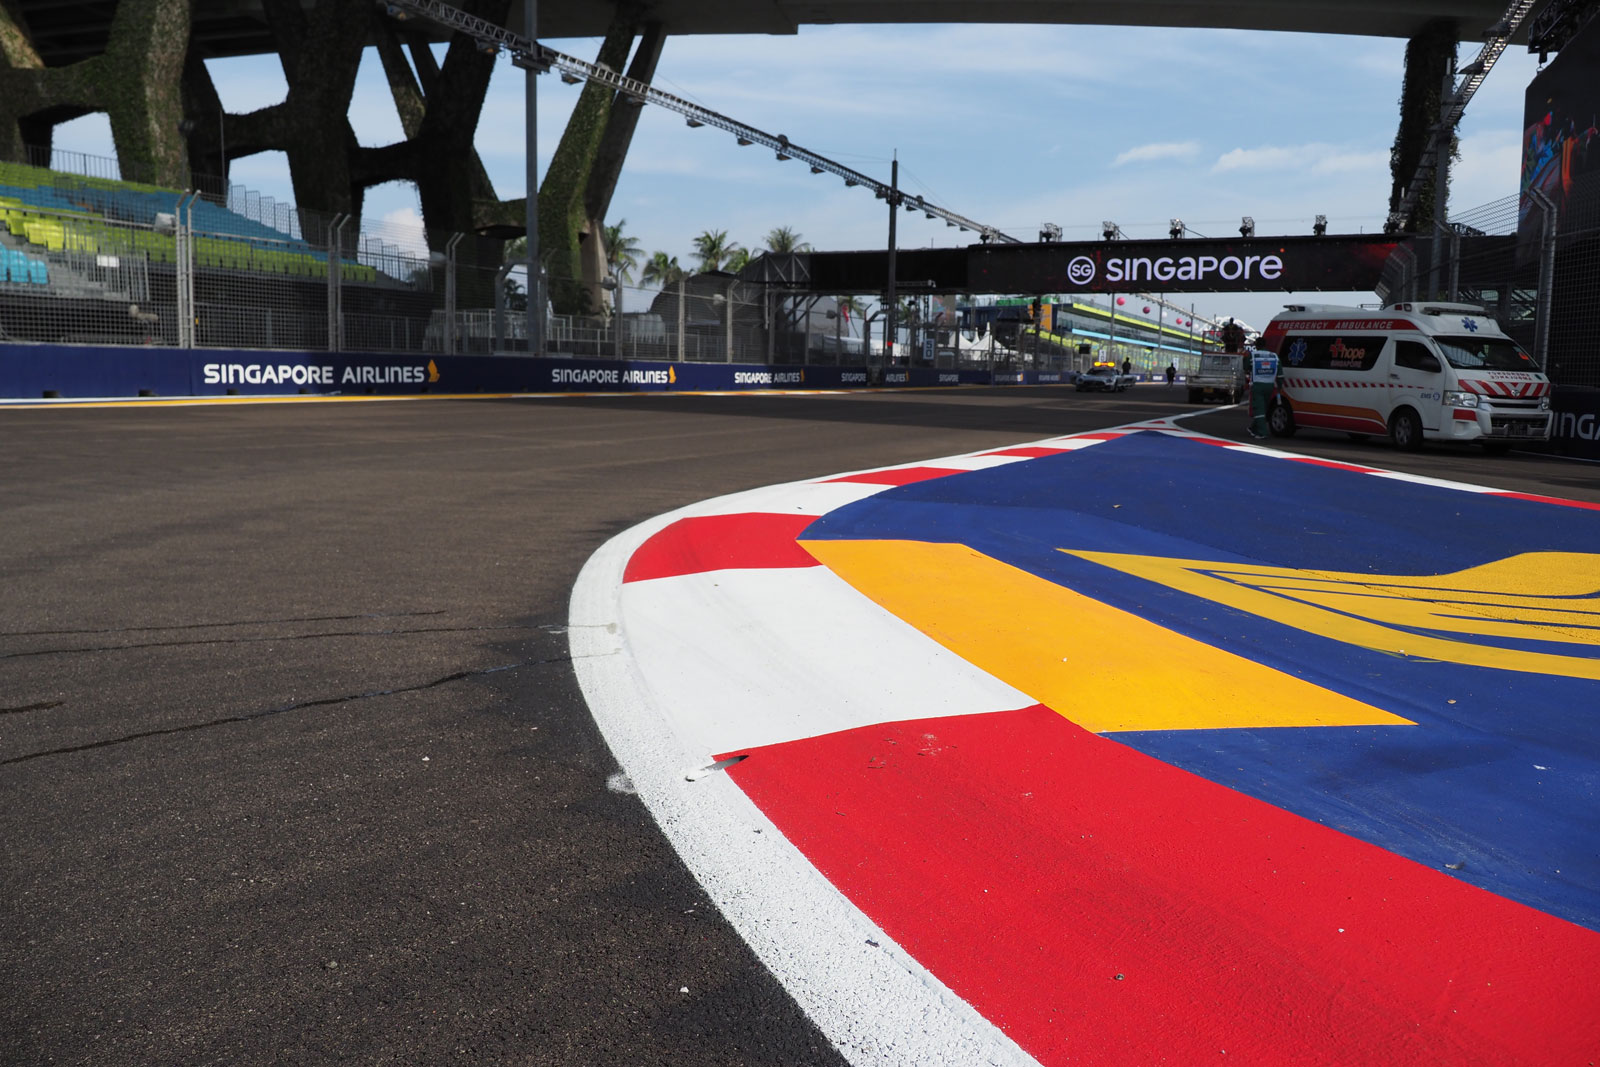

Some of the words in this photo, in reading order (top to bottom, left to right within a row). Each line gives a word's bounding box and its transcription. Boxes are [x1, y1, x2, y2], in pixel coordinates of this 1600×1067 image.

[1071, 263, 1092, 277] SG
[1278, 321, 1328, 330] EMERGENCY
[1335, 321, 1394, 330] AMBULANCE
[1340, 344, 1365, 361] hope
[203, 364, 334, 384] SINGAPORE
[342, 366, 425, 384] AIRLINES
[551, 369, 619, 384] SINGAPORE
[622, 370, 668, 384] AIRLINES
[734, 372, 772, 385] SINGAPORE
[774, 372, 800, 383] AIRLINES
[1552, 411, 1600, 440] ING
